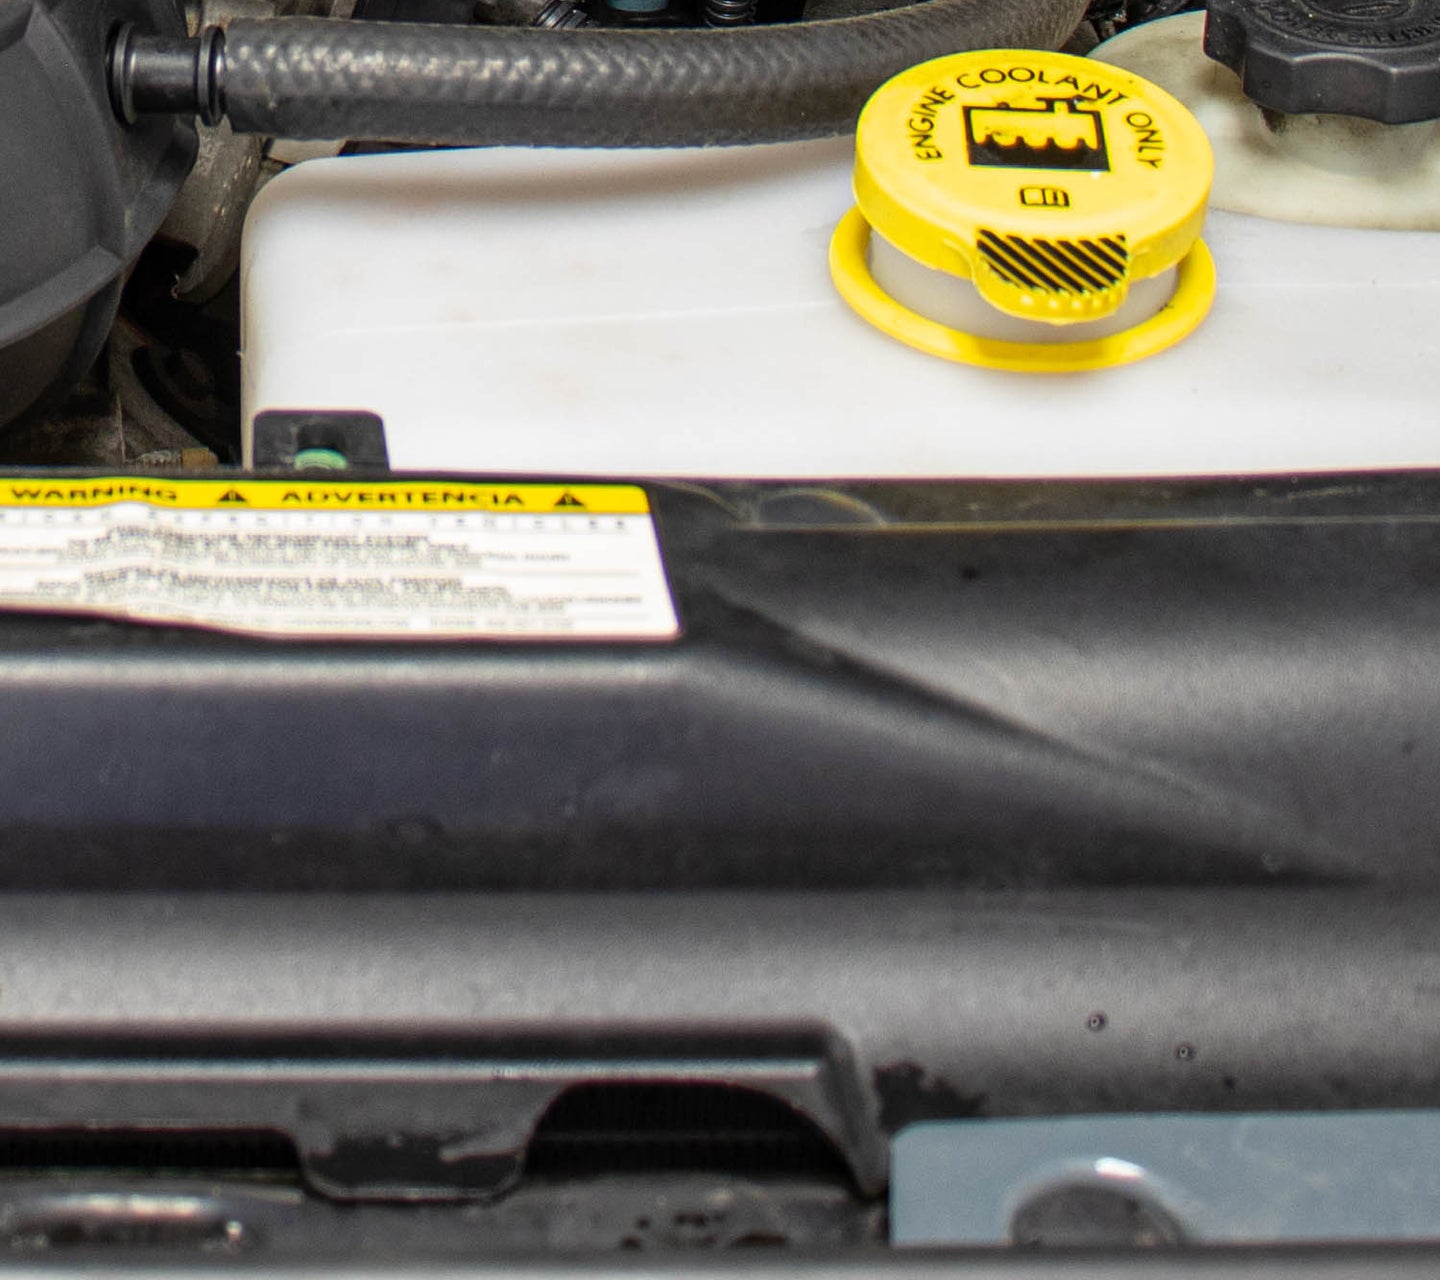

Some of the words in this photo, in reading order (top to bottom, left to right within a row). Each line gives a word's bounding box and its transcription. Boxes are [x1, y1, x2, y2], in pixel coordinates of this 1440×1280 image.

[907, 83, 959, 163] ENGINE
[955, 66, 1129, 107] COOLANT
[1125, 109, 1163, 170] ONLY
[9, 485, 178, 503] WARNING
[281, 488, 526, 507] ADVERTENCIA
